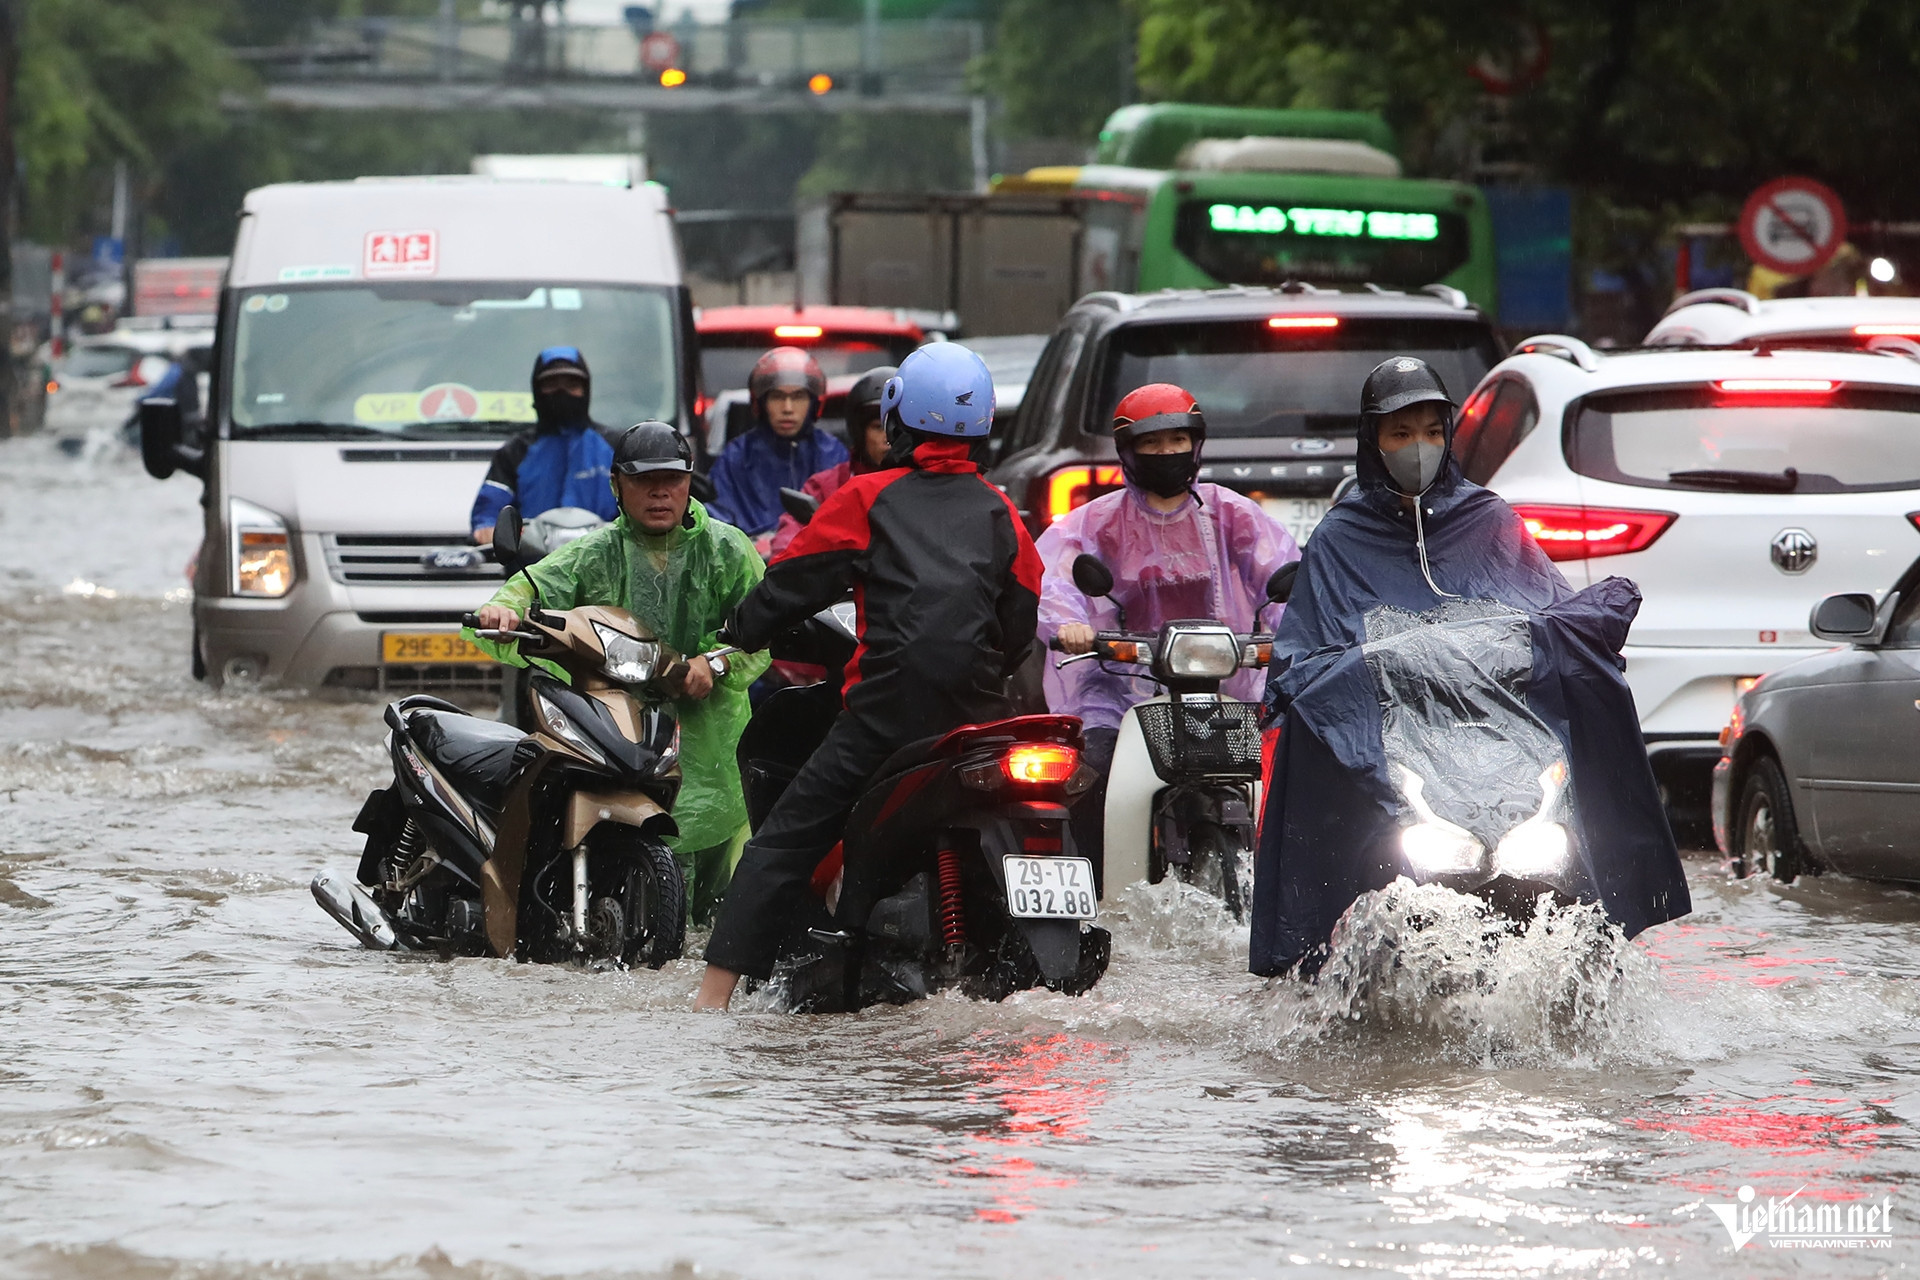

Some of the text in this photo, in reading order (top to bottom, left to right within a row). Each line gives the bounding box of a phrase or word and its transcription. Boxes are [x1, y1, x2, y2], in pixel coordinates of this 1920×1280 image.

[517, 746, 537, 758] HONDA
[1017, 860, 1080, 887] 29-T2
[1014, 888, 1091, 915] 032.88
